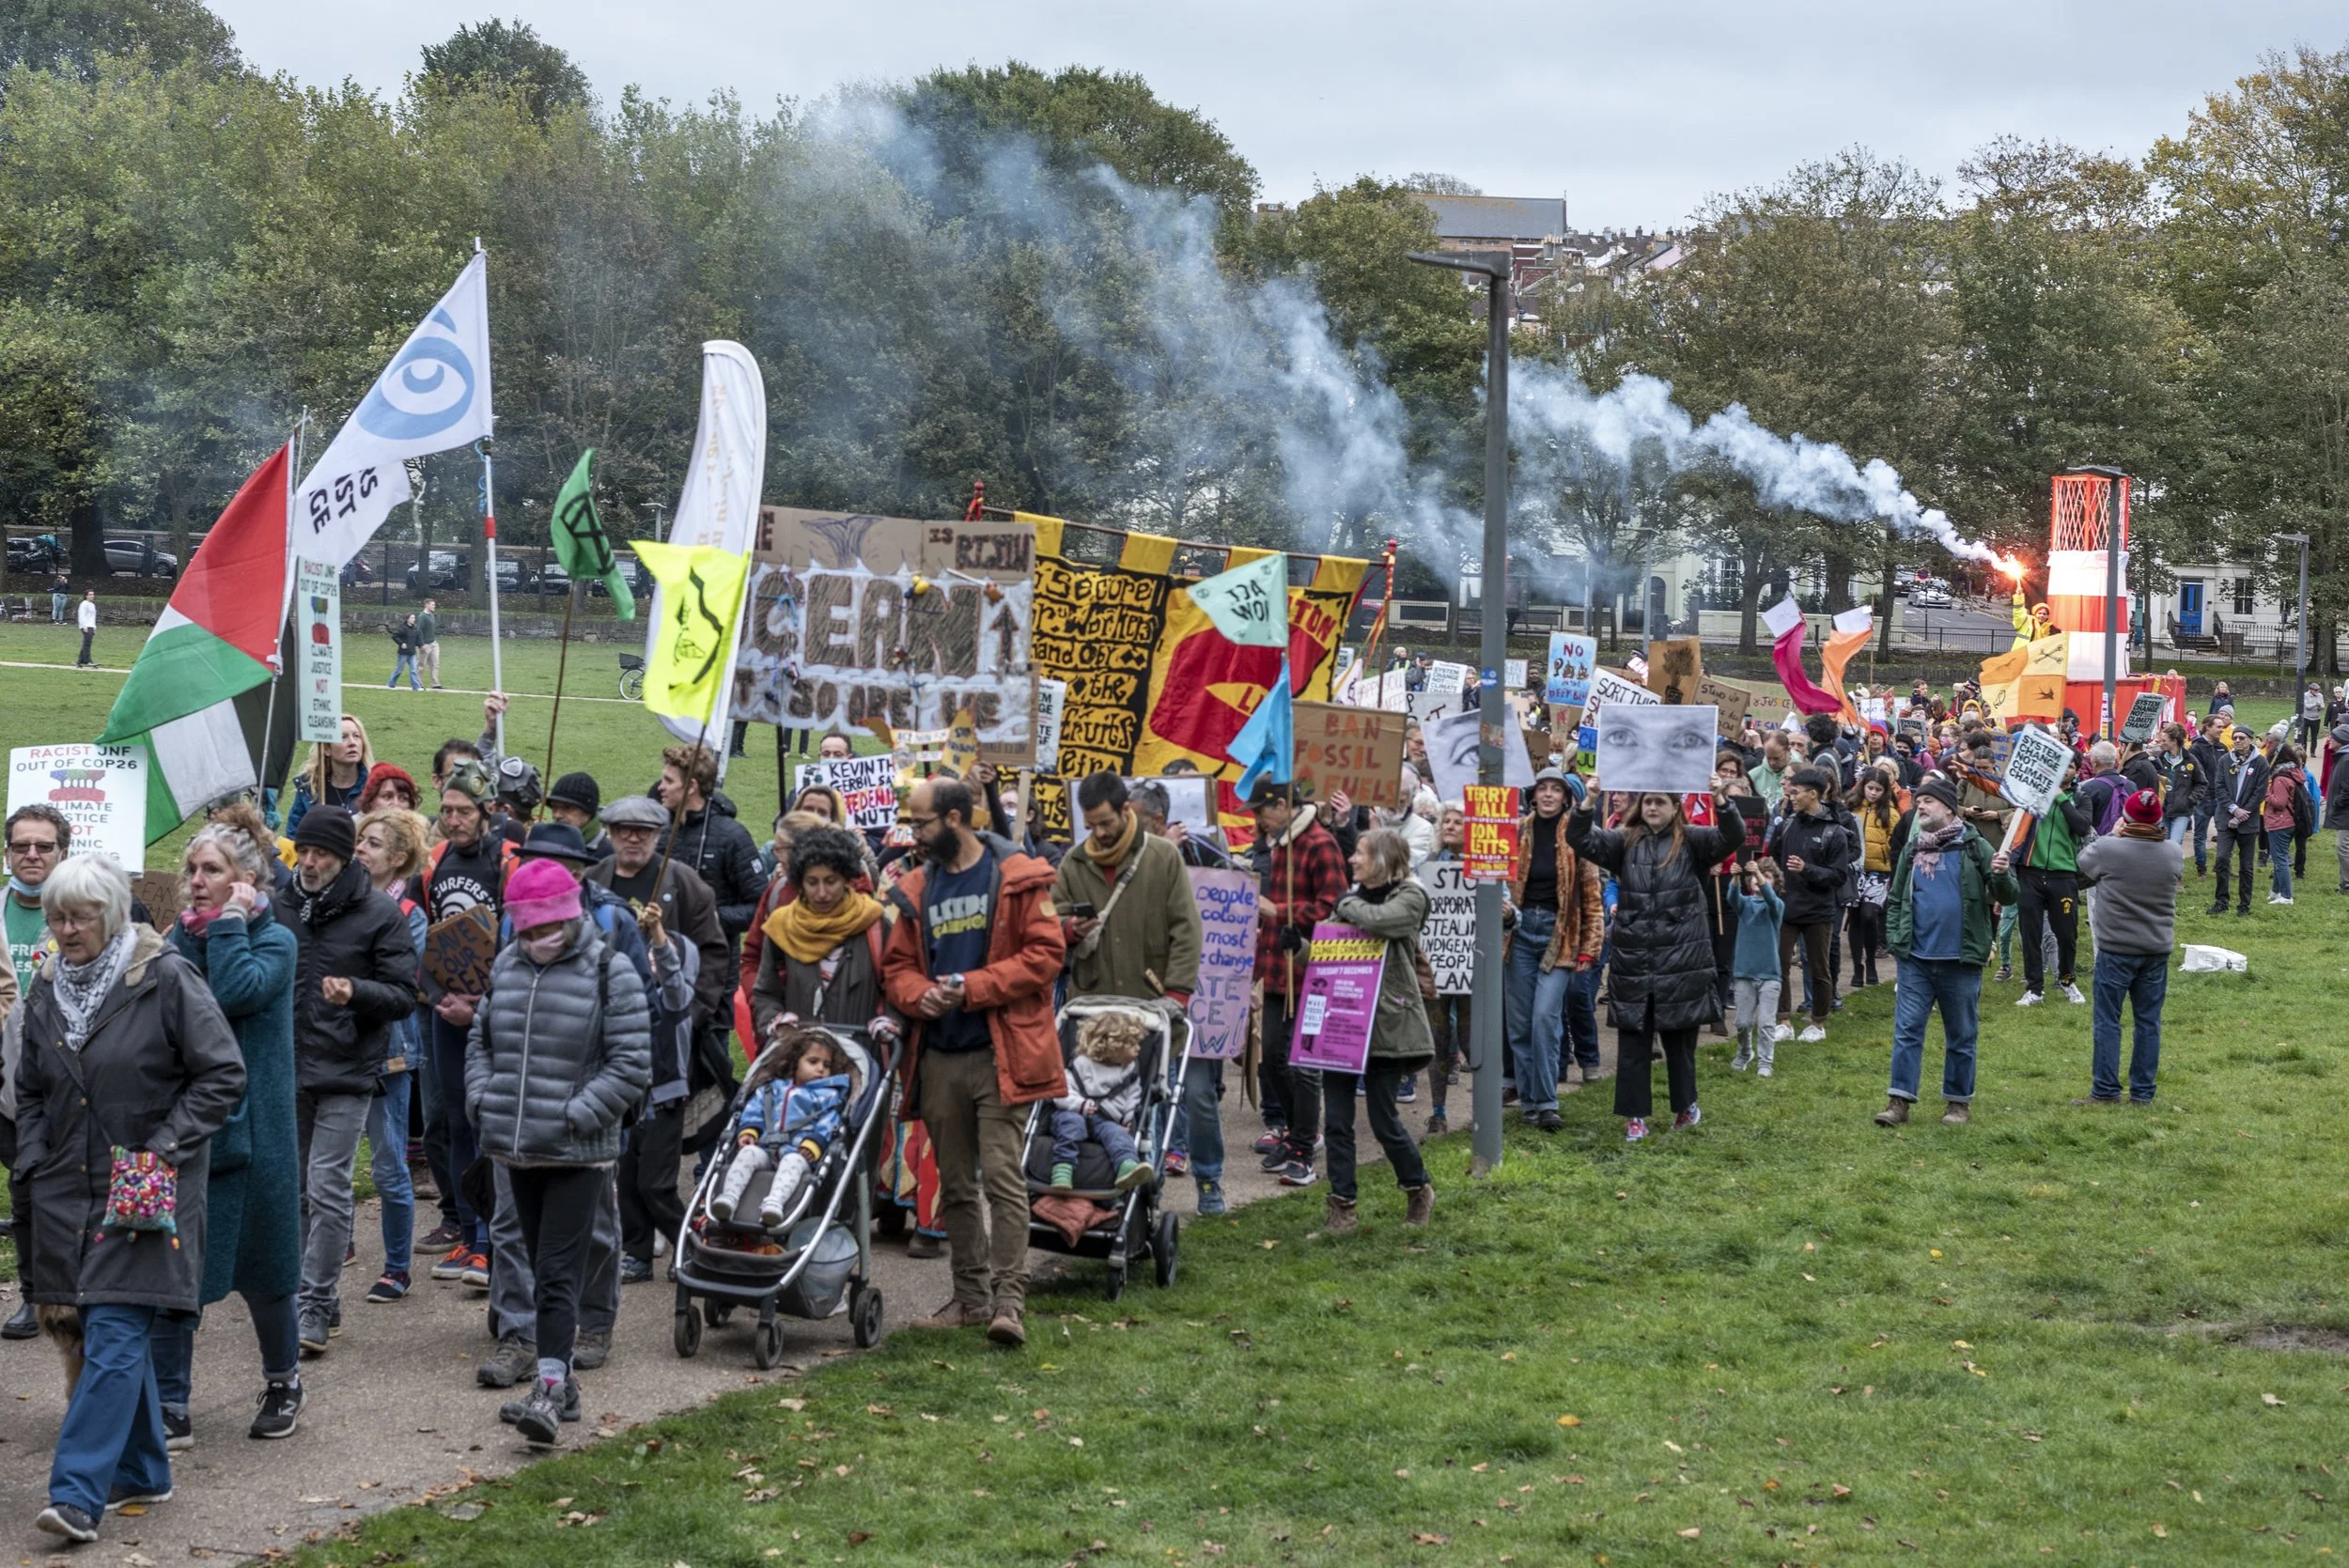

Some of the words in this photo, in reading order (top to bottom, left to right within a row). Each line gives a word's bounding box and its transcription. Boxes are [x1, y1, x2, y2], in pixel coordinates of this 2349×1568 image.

[928, 527, 953, 544] IS
[1563, 643, 1585, 658] NO
[2133, 705, 2159, 713] CHANGE
[2134, 699, 2161, 707] SYSTEM
[1325, 712, 1381, 741] BAN
[2124, 721, 2152, 729] CHANGE
[2127, 716, 2155, 724] CLIMATE
[30, 746, 91, 759] RACIST
[98, 746, 132, 757] JNF
[1294, 738, 1381, 770] FOSSIL
[2019, 743, 2061, 772] CHANGE
[2022, 735, 2062, 763] SYSTEM
[16, 762, 46, 772] OUT
[54, 759, 76, 768] OF
[83, 758, 138, 769] COP26
[830, 759, 877, 779] KEVIN
[879, 758, 895, 773] TH
[2015, 751, 2037, 768] NOT
[2009, 768, 2049, 795] CHANGE
[2013, 759, 2054, 789] CLIMATE
[831, 775, 876, 793] GERBIL
[1323, 772, 1398, 805] FUELS
[1465, 785, 1512, 803] TERRY
[70, 825, 95, 836] OT
[1470, 838, 1511, 855] LETTS
[1433, 867, 1478, 891] STO
[433, 876, 490, 902] SURFERS
[1429, 895, 1476, 915] ORPORAT
[1201, 906, 1253, 925] colour
[1421, 918, 1476, 937] STEALIN
[1206, 927, 1250, 949] most
[1422, 938, 1475, 954] INDIGEN
[1208, 946, 1254, 975] change
[1430, 954, 1473, 970] PEOPL
[1433, 970, 1472, 990] LAN
